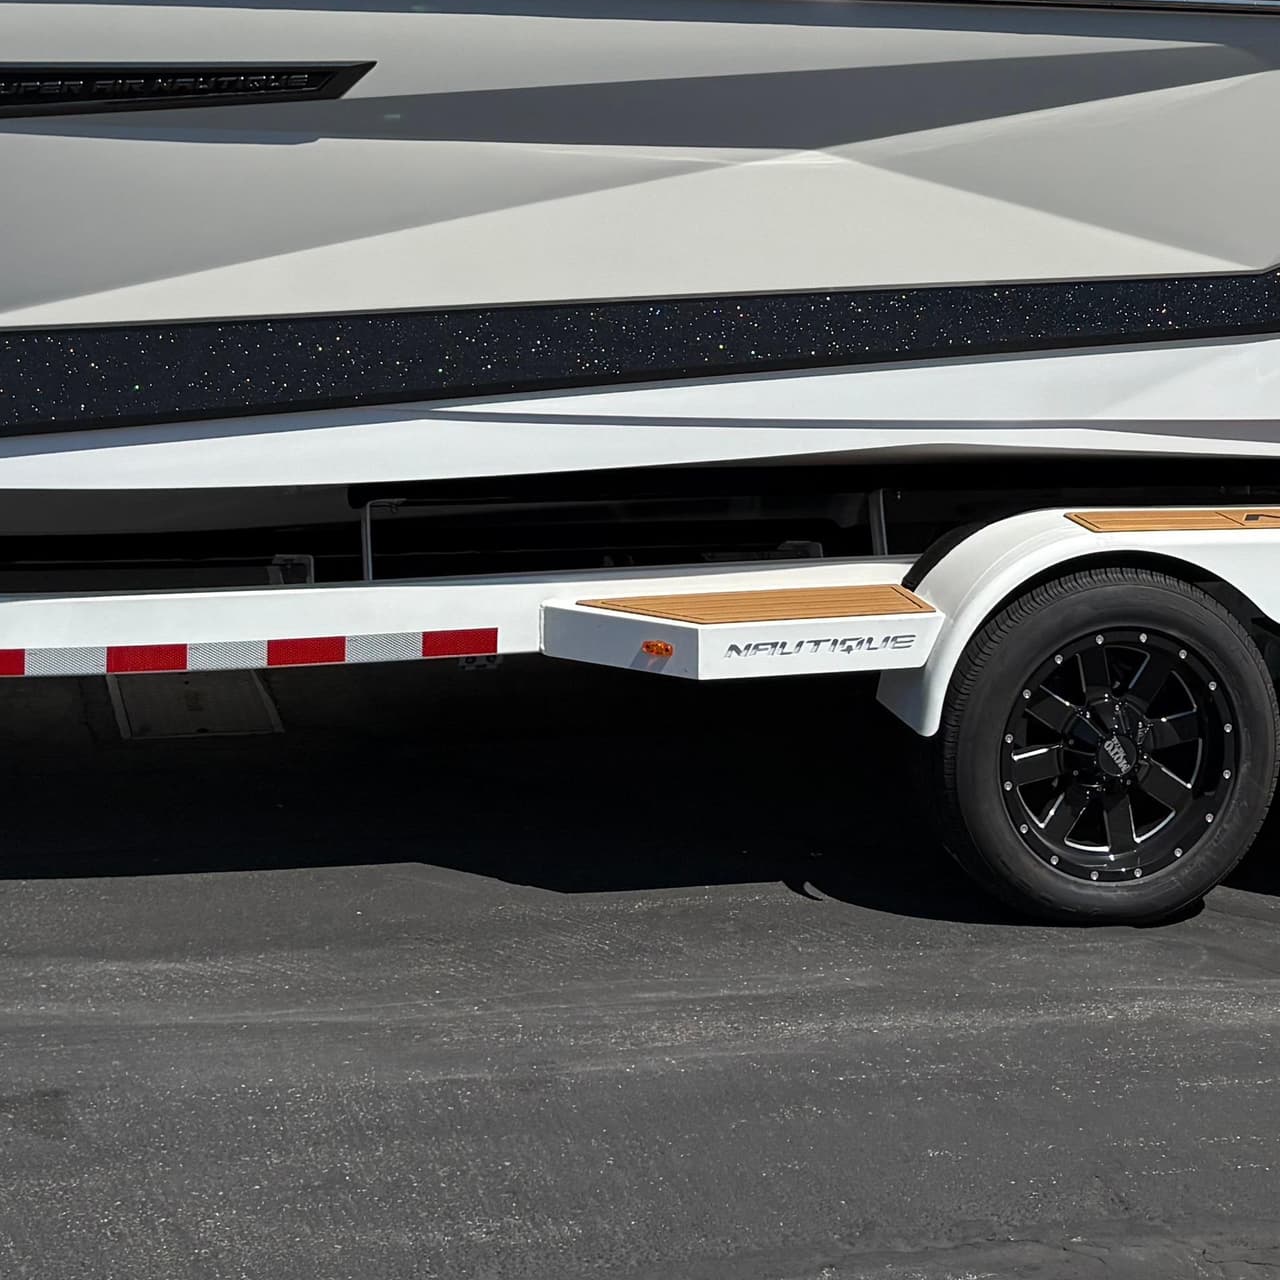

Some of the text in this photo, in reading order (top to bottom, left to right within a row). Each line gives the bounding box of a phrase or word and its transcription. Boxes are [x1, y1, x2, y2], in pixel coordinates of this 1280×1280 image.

[93, 75, 145, 95] AIR
[151, 71, 310, 93] NAUTIQUE
[723, 633, 917, 659] NAUTIQUE
